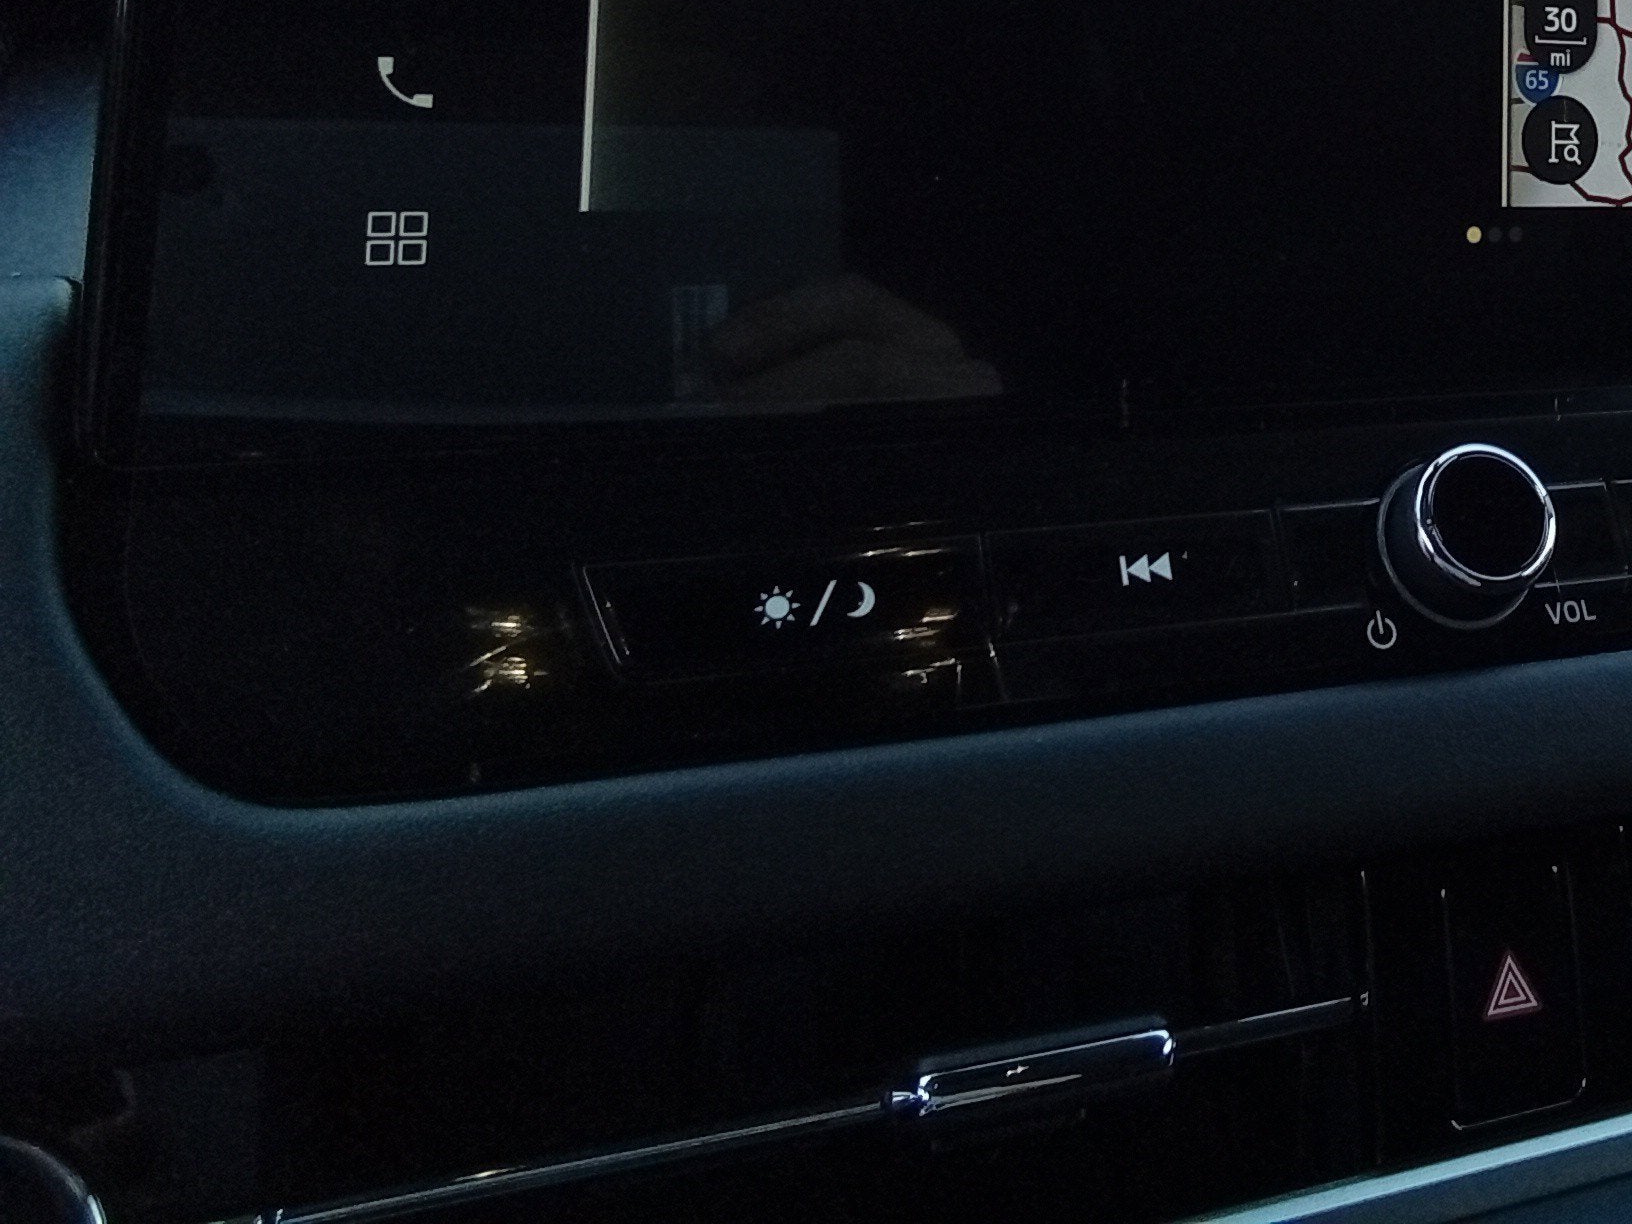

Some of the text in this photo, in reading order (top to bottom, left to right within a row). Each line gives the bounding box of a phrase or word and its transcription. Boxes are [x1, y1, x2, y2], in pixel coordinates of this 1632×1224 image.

[1544, 6, 1577, 33] 30
[1550, 49, 1571, 67] mi
[1525, 69, 1549, 90] 65
[1544, 599, 1597, 625] VOL
